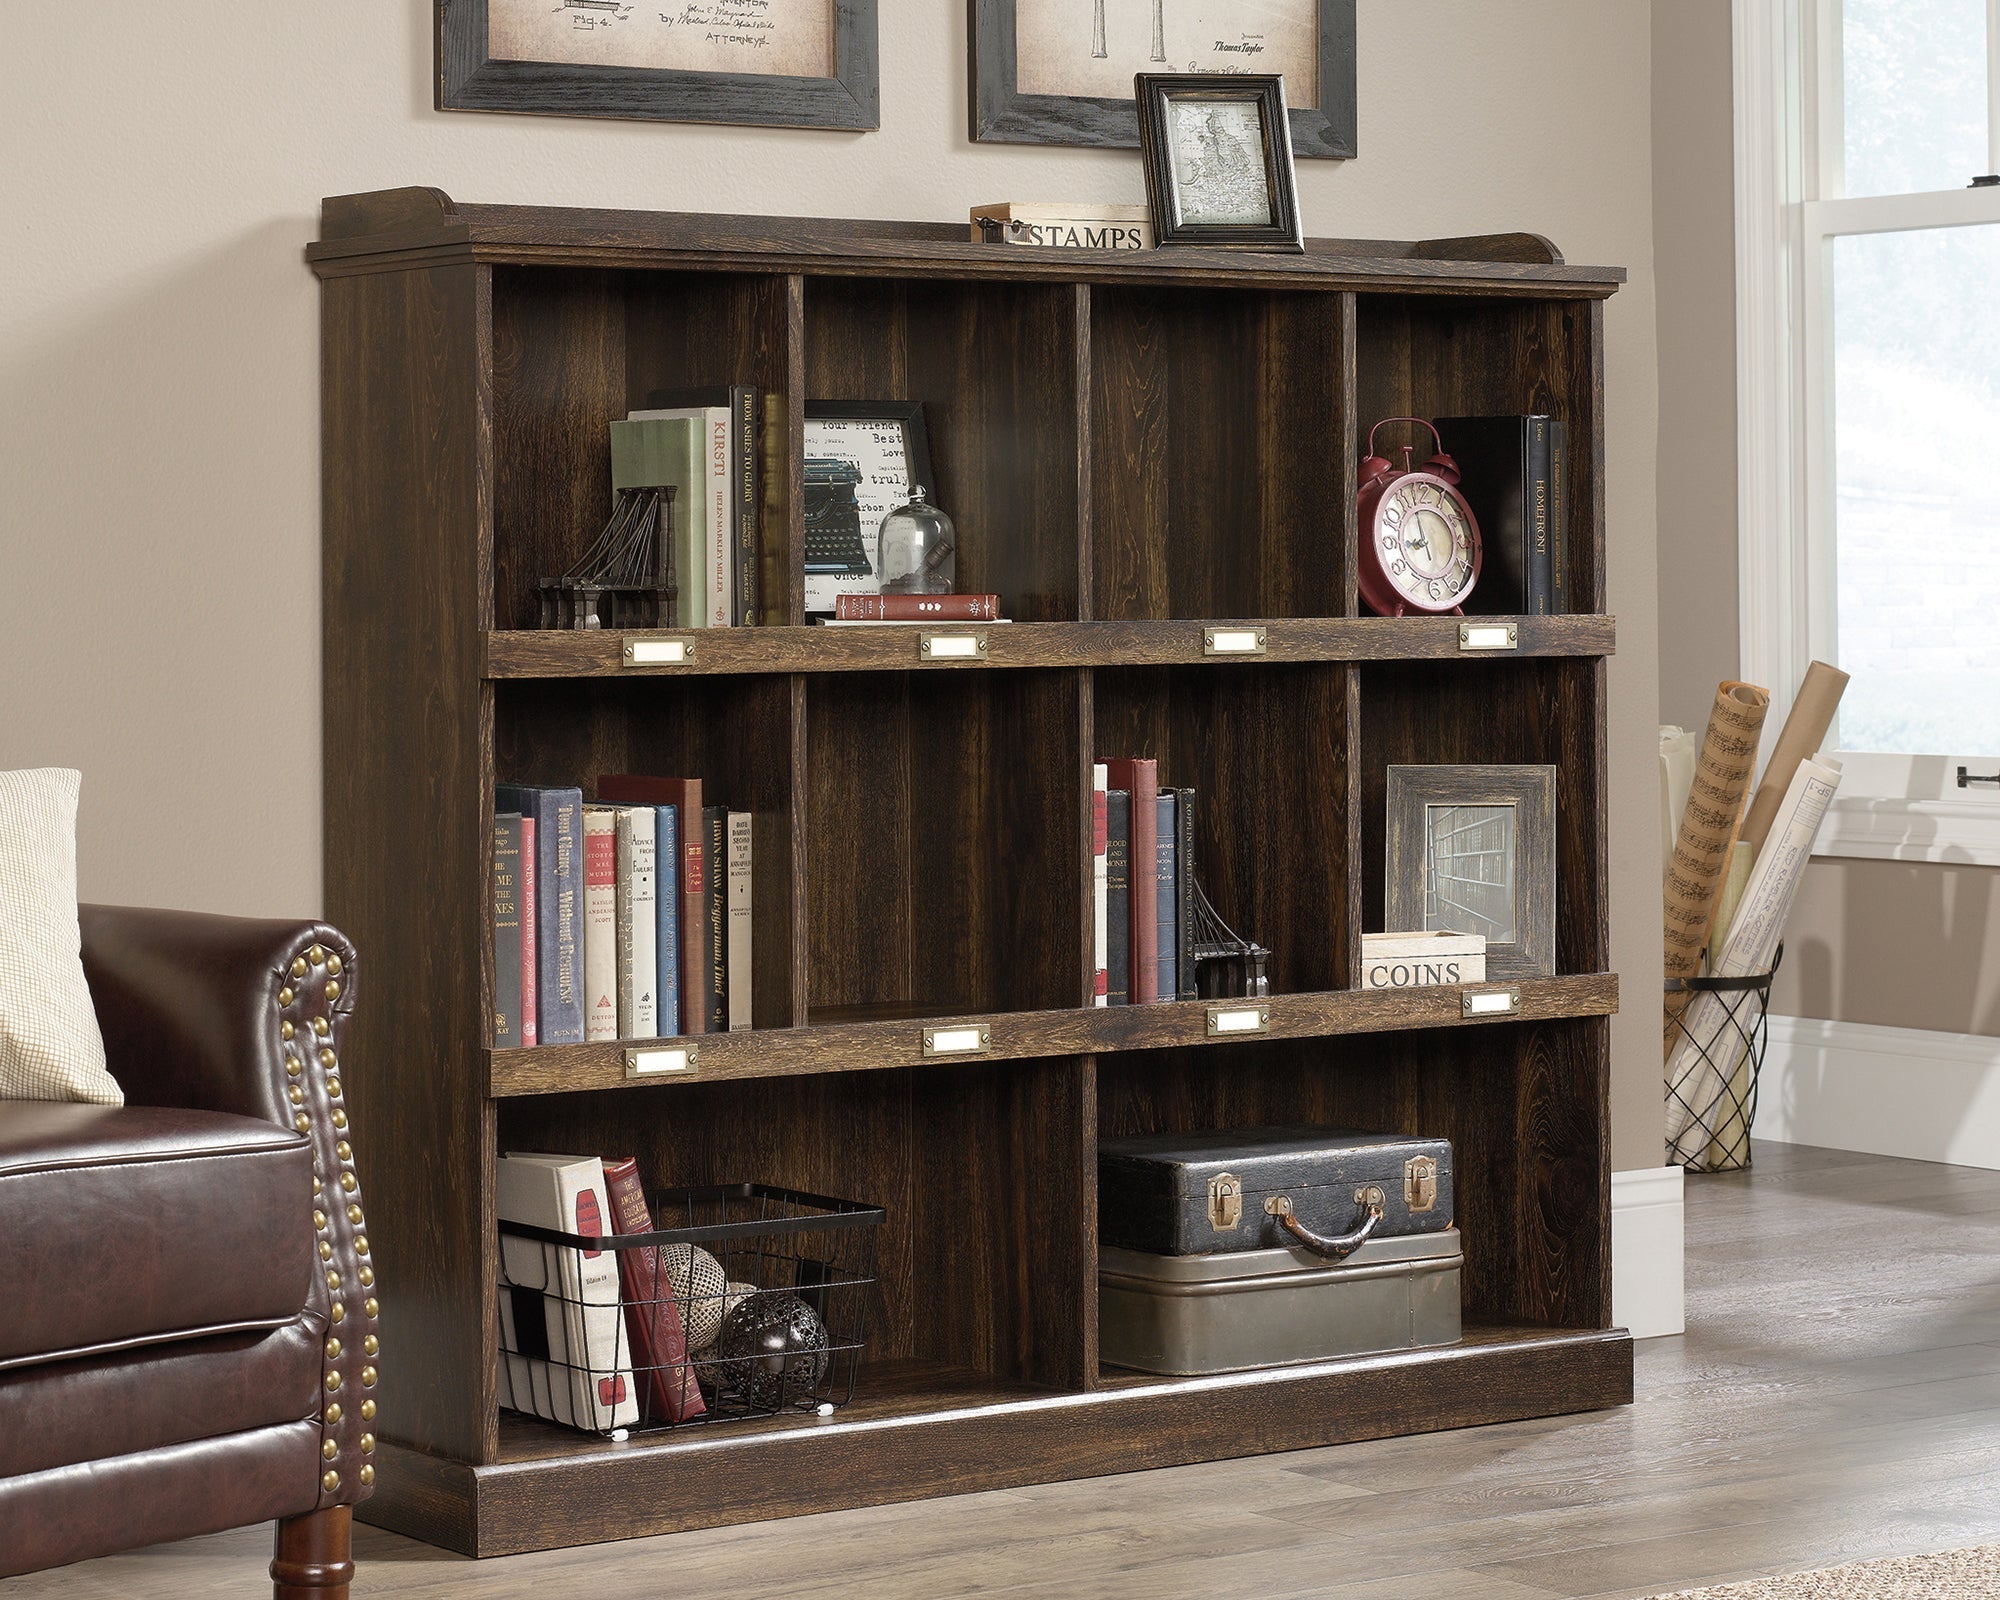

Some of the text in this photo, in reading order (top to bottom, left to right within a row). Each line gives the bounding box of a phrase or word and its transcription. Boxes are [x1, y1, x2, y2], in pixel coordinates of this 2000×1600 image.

[1213, 41, 1264, 56] Thomas Taylor
[1029, 225, 1143, 250] STAMPS
[821, 421, 848, 430] Your
[714, 422, 727, 477] KIRSTI
[744, 393, 753, 503] FROM ASHES TO GLORY
[872, 433, 903, 444] Best
[882, 449, 905, 458] Love
[871, 473, 908, 486] truly
[1535, 480, 1545, 555] HOMEFRONT
[553, 804, 574, 878] Tom Clancy
[713, 819, 722, 889] IRWIN SHAW
[495, 874, 513, 885] ME
[525, 863, 533, 887] NEW
[495, 902, 515, 914] XES
[526, 891, 534, 944] FRONTIERS
[558, 889, 575, 1005] Without Remorse
[714, 964, 725, 997] Thief
[1369, 962, 1461, 988] COINS
